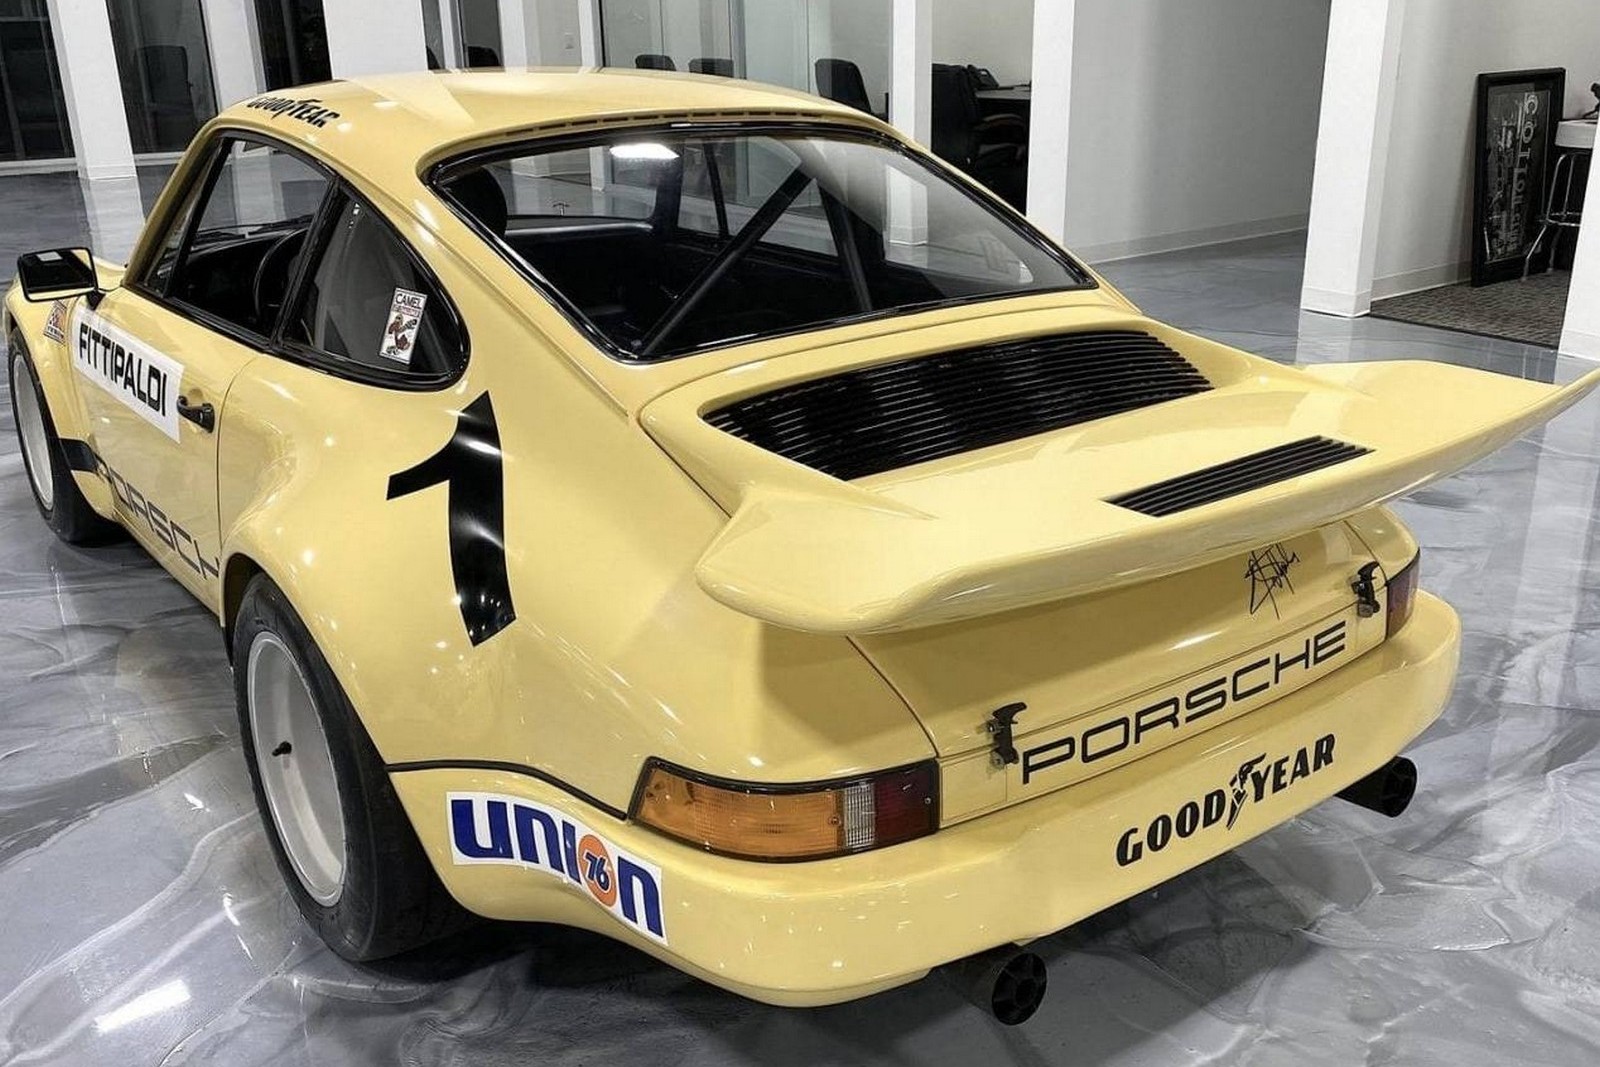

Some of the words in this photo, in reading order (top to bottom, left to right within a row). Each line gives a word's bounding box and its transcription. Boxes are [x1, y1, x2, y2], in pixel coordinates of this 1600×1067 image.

[395, 292, 422, 310] CAMEL
[78, 322, 168, 417] FITTIPALDI
[94, 452, 220, 580] PORSCH
[386, 389, 517, 648] 1
[1022, 620, 1347, 785] PORSCHE
[1115, 733, 1337, 868] GOODYEAR
[584, 851, 612, 892] 76
